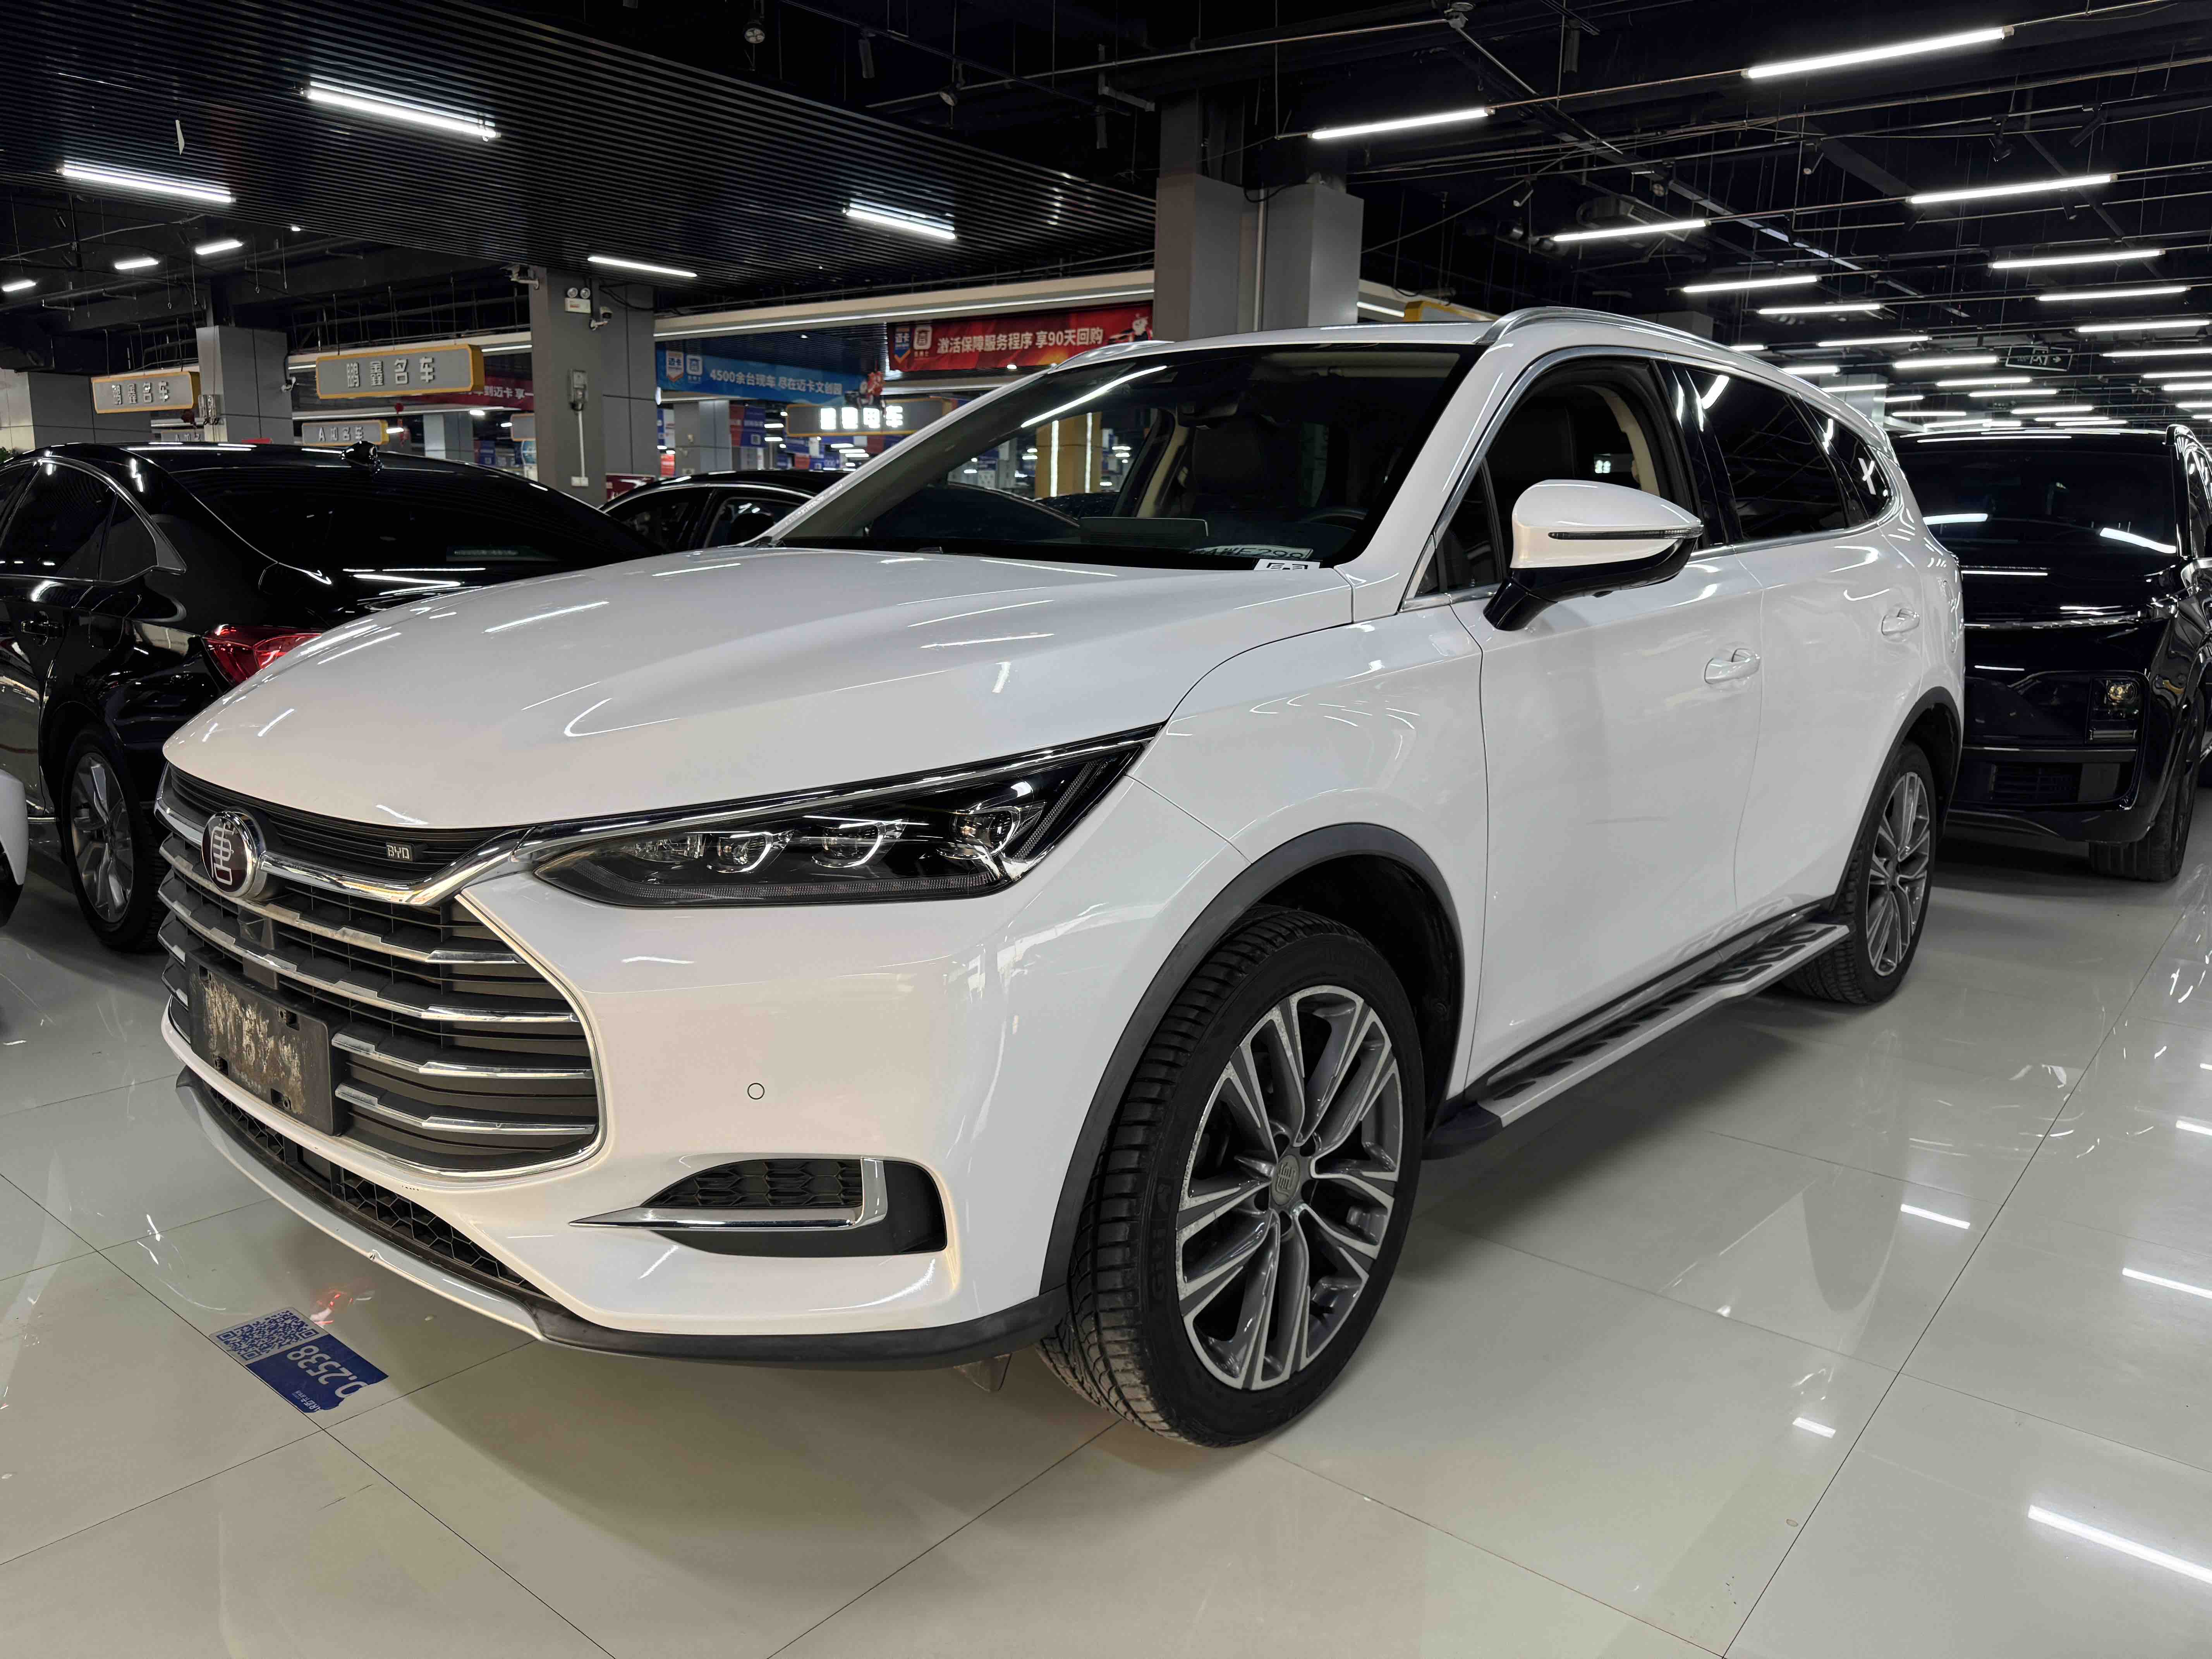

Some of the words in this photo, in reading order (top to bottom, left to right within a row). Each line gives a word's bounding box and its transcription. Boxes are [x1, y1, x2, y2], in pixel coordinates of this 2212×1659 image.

[936, 332, 1033, 354] 激活保障服务程序
[1035, 327, 1104, 348] 享90天回购
[710, 369, 776, 388] 4500余台现车
[387, 845, 410, 859] BYD
